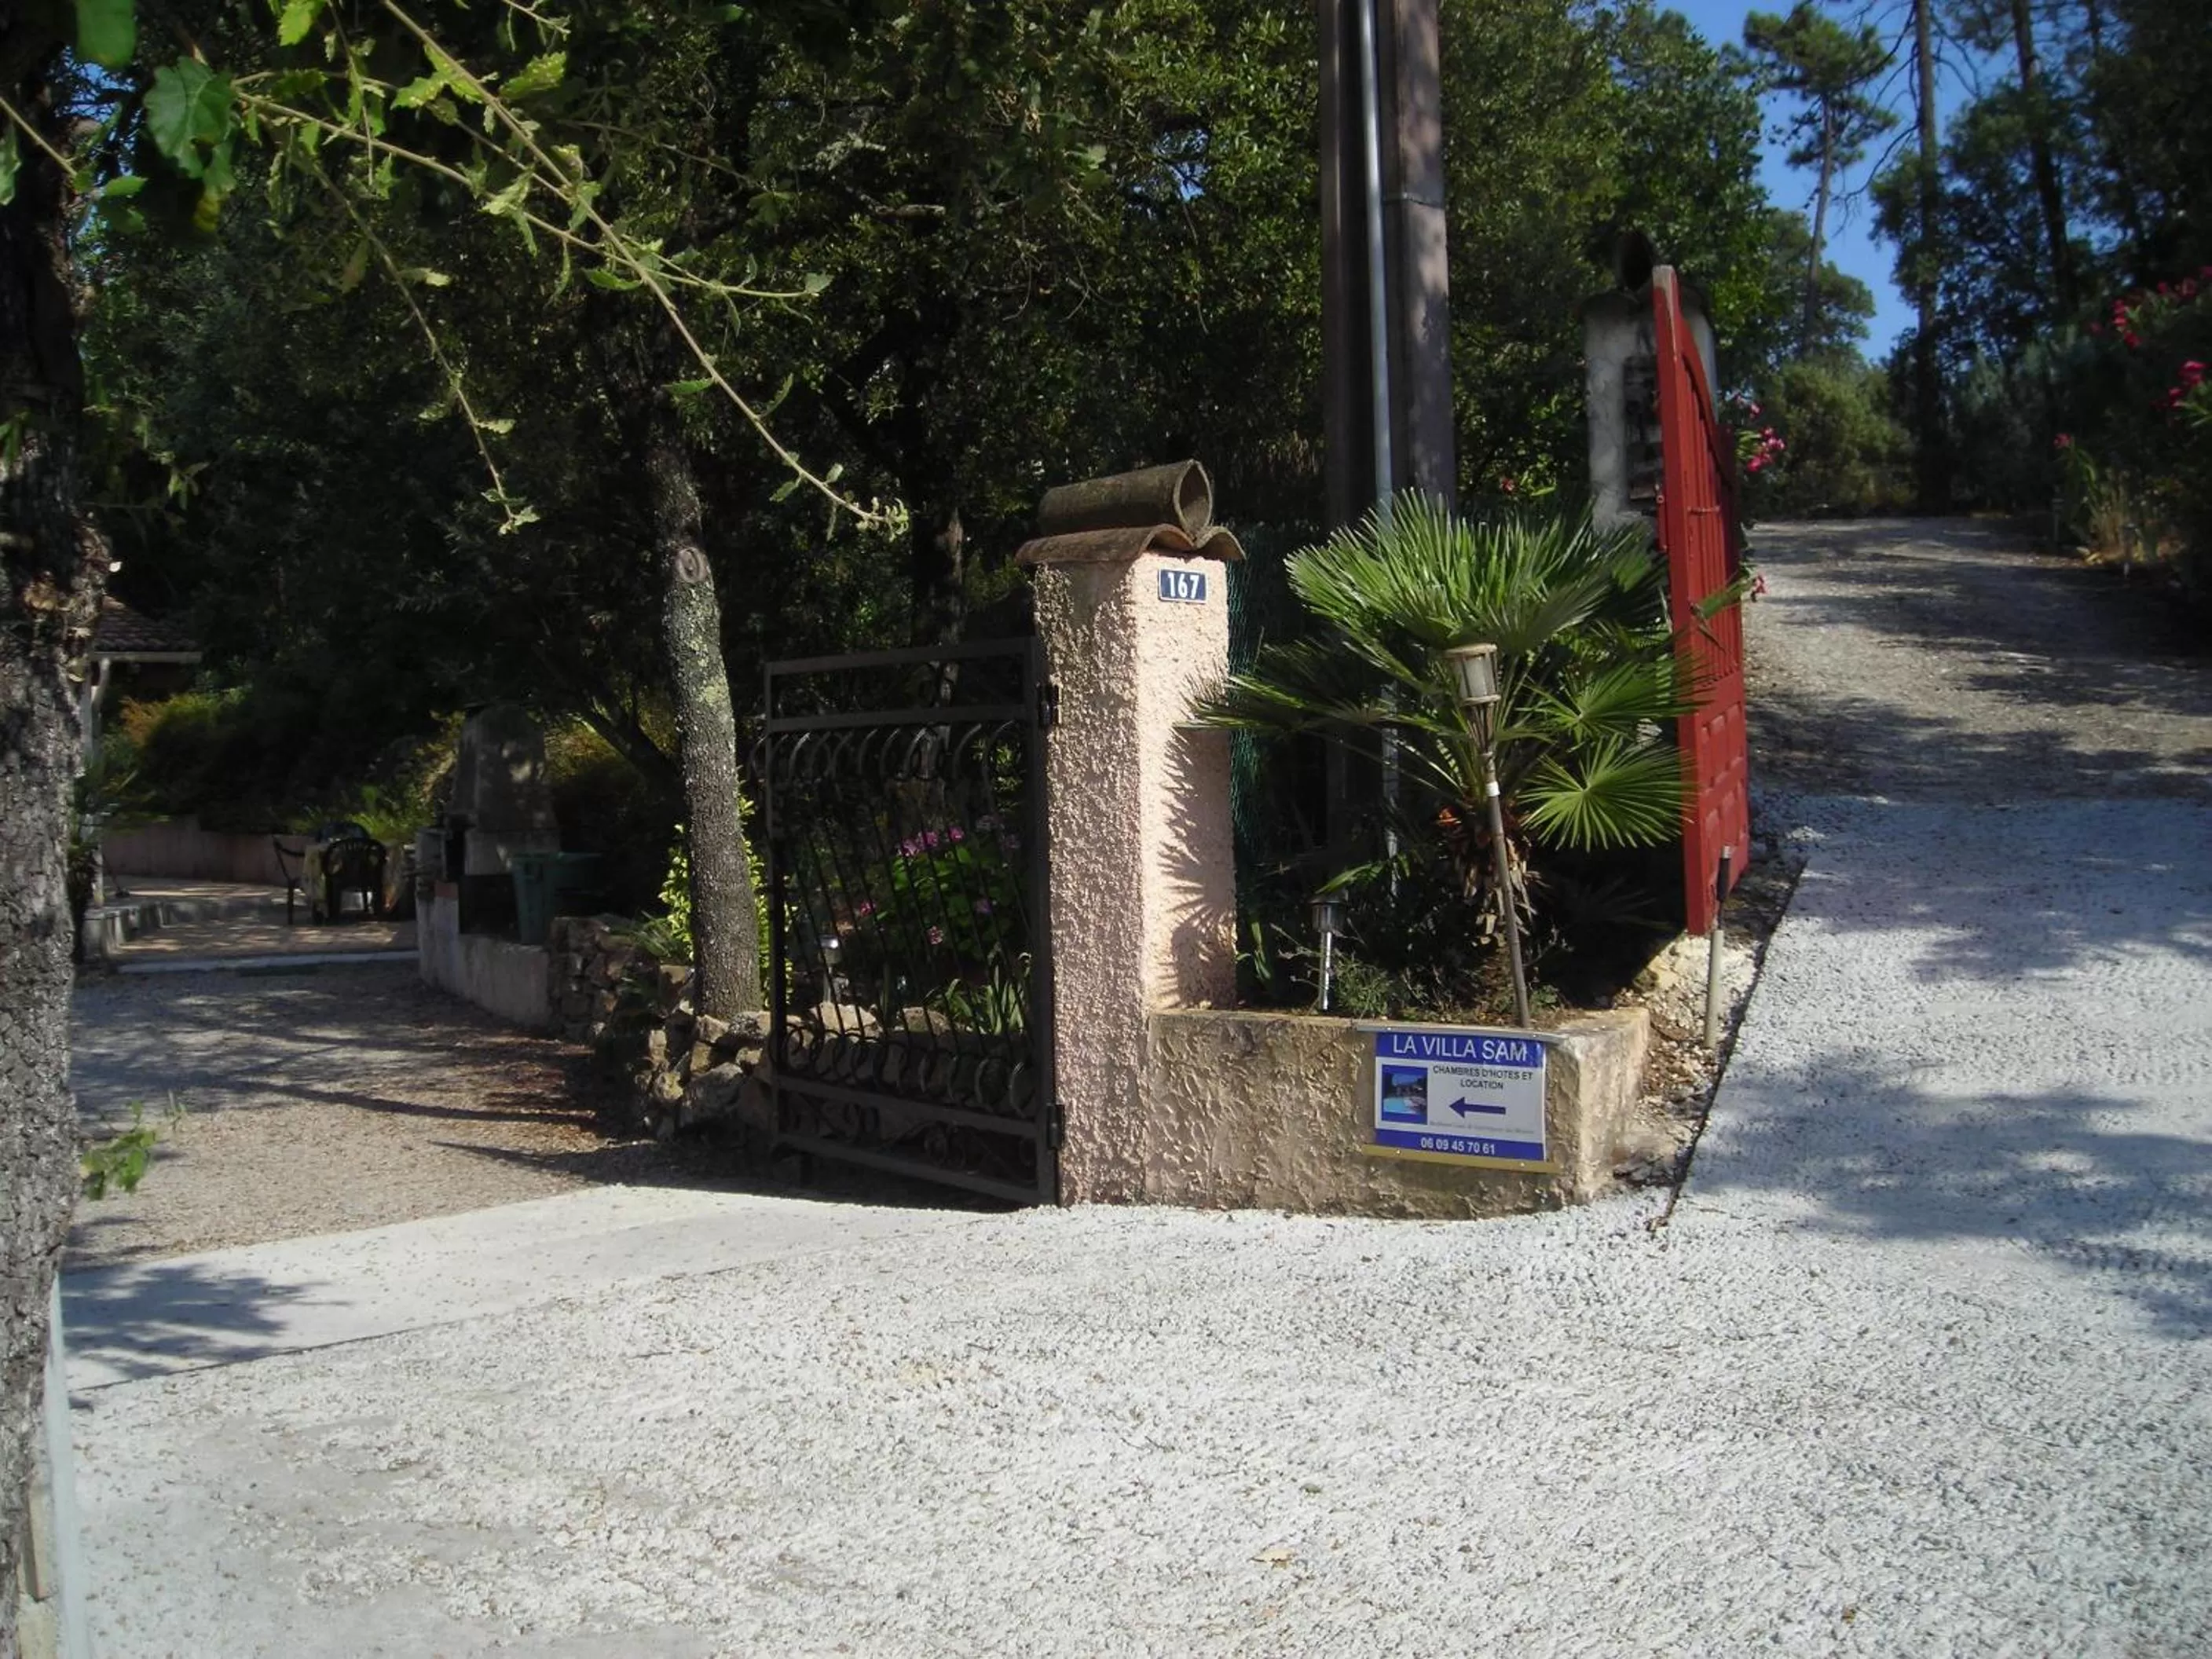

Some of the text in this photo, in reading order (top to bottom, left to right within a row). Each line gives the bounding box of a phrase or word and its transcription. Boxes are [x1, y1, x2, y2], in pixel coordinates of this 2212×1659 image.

[1167, 571, 1199, 599] 167
[1393, 1035, 1528, 1062] LA VILLA SAM
[1433, 1066, 1480, 1077] CHAMBRES
[1522, 1071, 1533, 1080] ET
[1460, 1079, 1503, 1090] LOCATION
[1436, 1138, 1448, 1150] 09
[1451, 1140, 1465, 1152] 45
[1467, 1141, 1480, 1153] 70
[1482, 1143, 1495, 1155] 61
